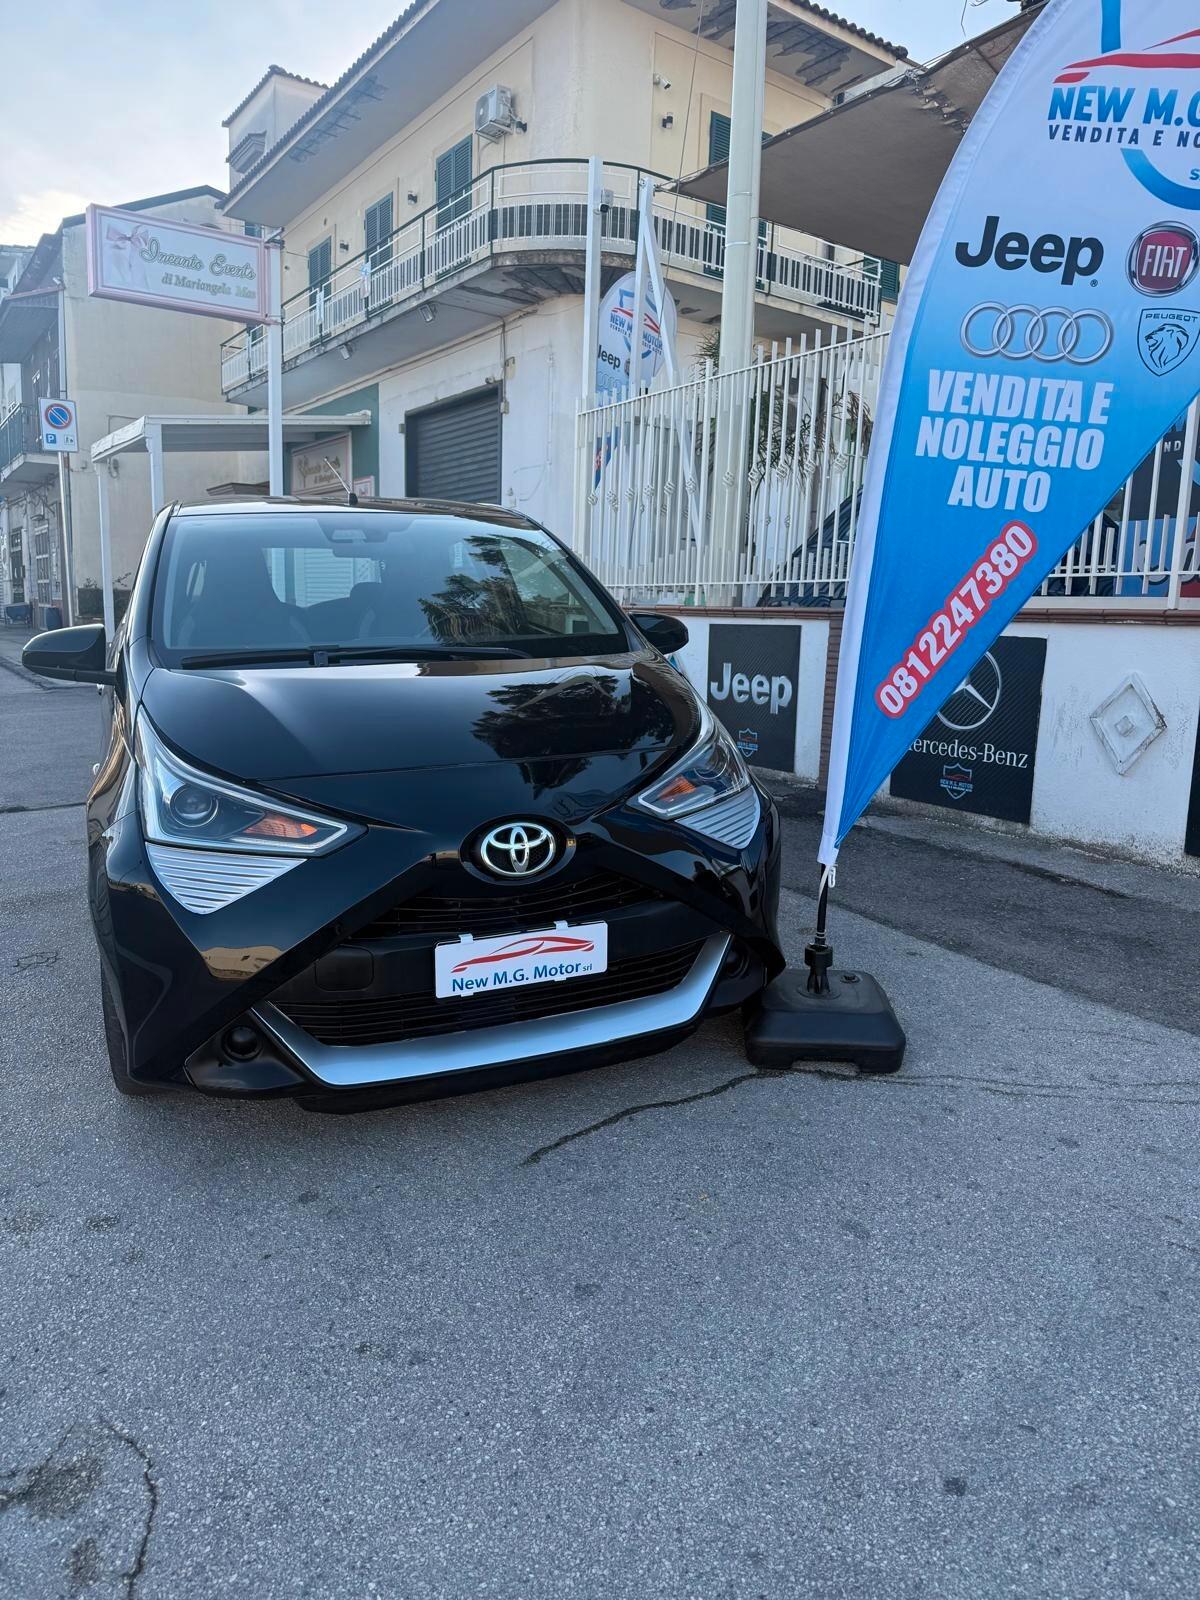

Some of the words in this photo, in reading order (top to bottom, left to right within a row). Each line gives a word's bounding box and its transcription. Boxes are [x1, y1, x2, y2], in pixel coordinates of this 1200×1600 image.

[1048, 85, 1136, 123] NEW
[1048, 124, 1140, 145] VENDITA
[1152, 129, 1164, 146] E
[955, 215, 1104, 286] Jeep
[1141, 244, 1188, 278] FIAT
[609, 312, 626, 328] NEW
[1145, 313, 1199, 323] PEUGEOT
[927, 369, 1081, 423] VENDITA
[1088, 382, 1114, 425] E
[915, 416, 1105, 471] NOLEGGIO
[947, 465, 1050, 513] AUTO
[880, 525, 1033, 714] 0812247380
[710, 662, 793, 715] Jeep
[908, 738, 1029, 769] ercedes-Benz
[452, 976, 488, 992] New
[493, 968, 529, 986] M.G.
[533, 962, 581, 979] Motor
[582, 964, 593, 972] srl
